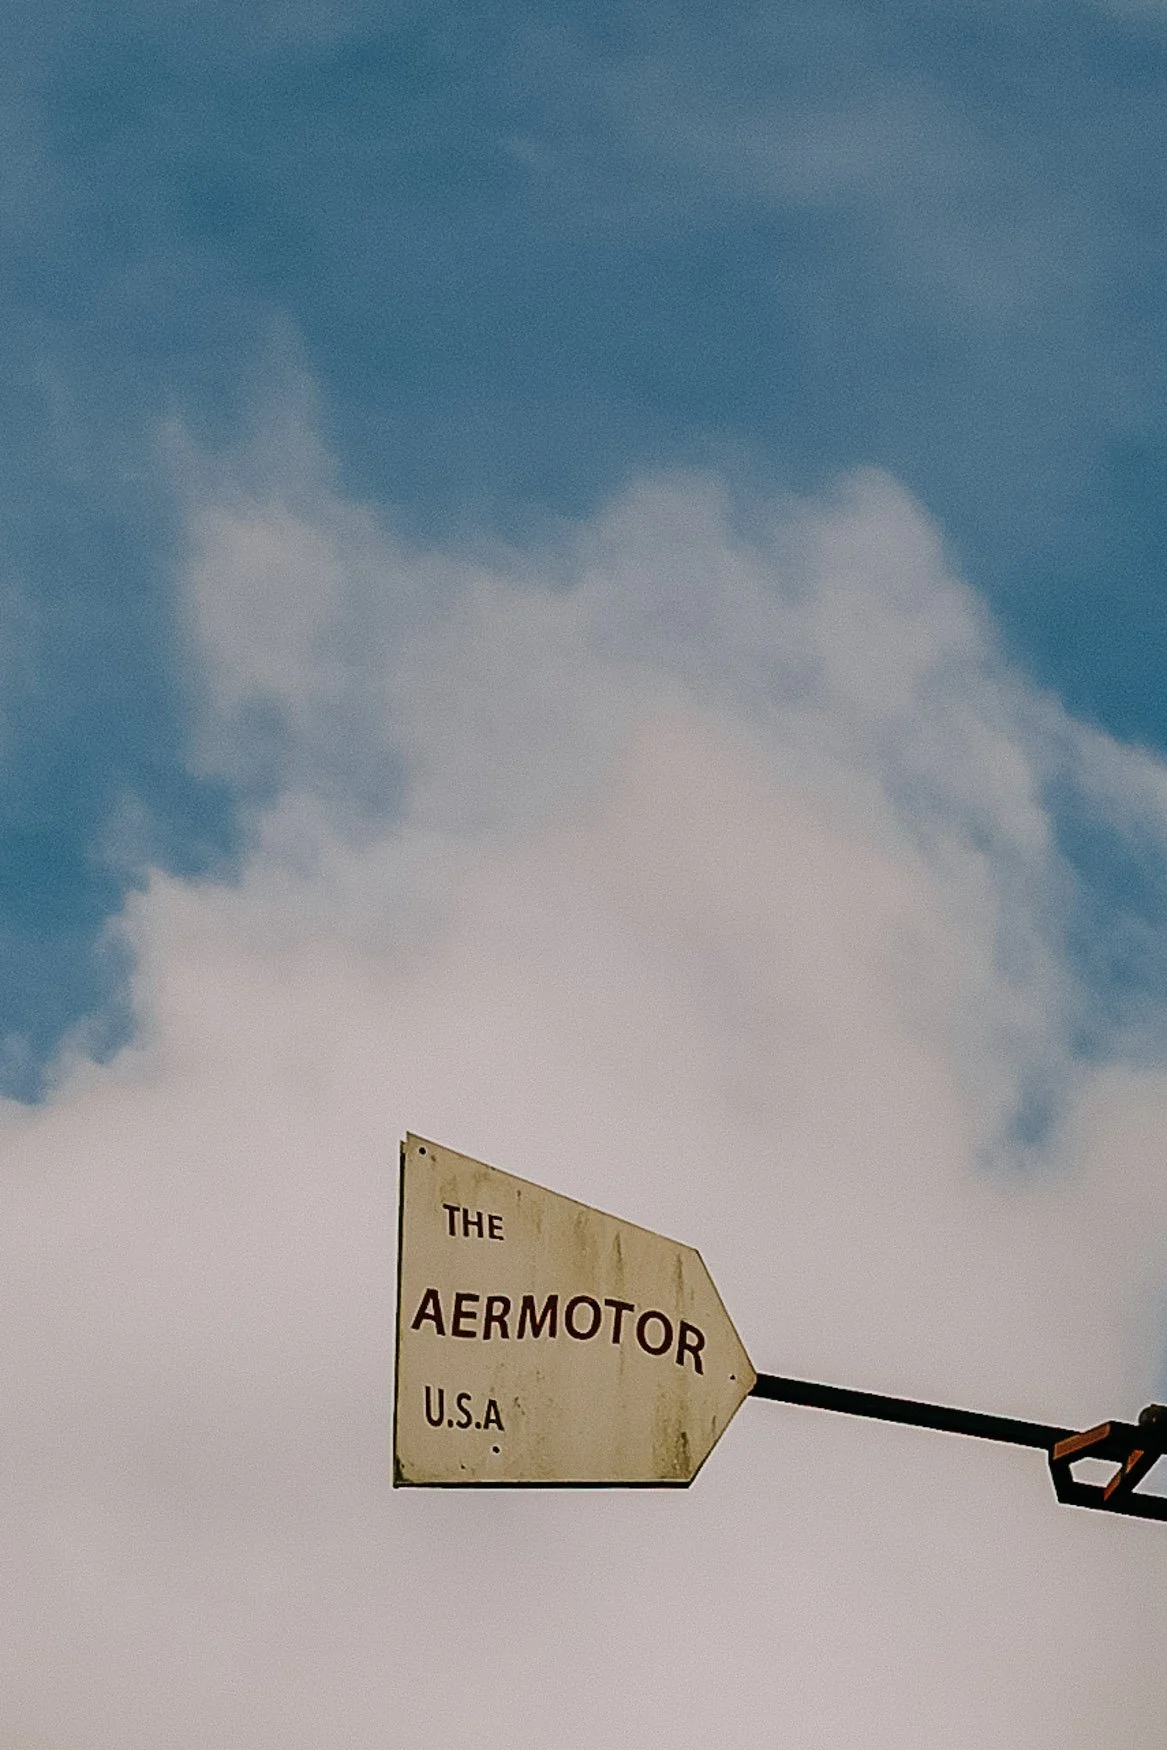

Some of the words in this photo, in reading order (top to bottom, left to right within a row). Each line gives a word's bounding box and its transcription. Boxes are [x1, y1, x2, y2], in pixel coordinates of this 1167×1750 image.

[443, 1203, 504, 1240] THE
[411, 1288, 706, 1375] AERMOTOR
[425, 1386, 505, 1431] U.S.A
